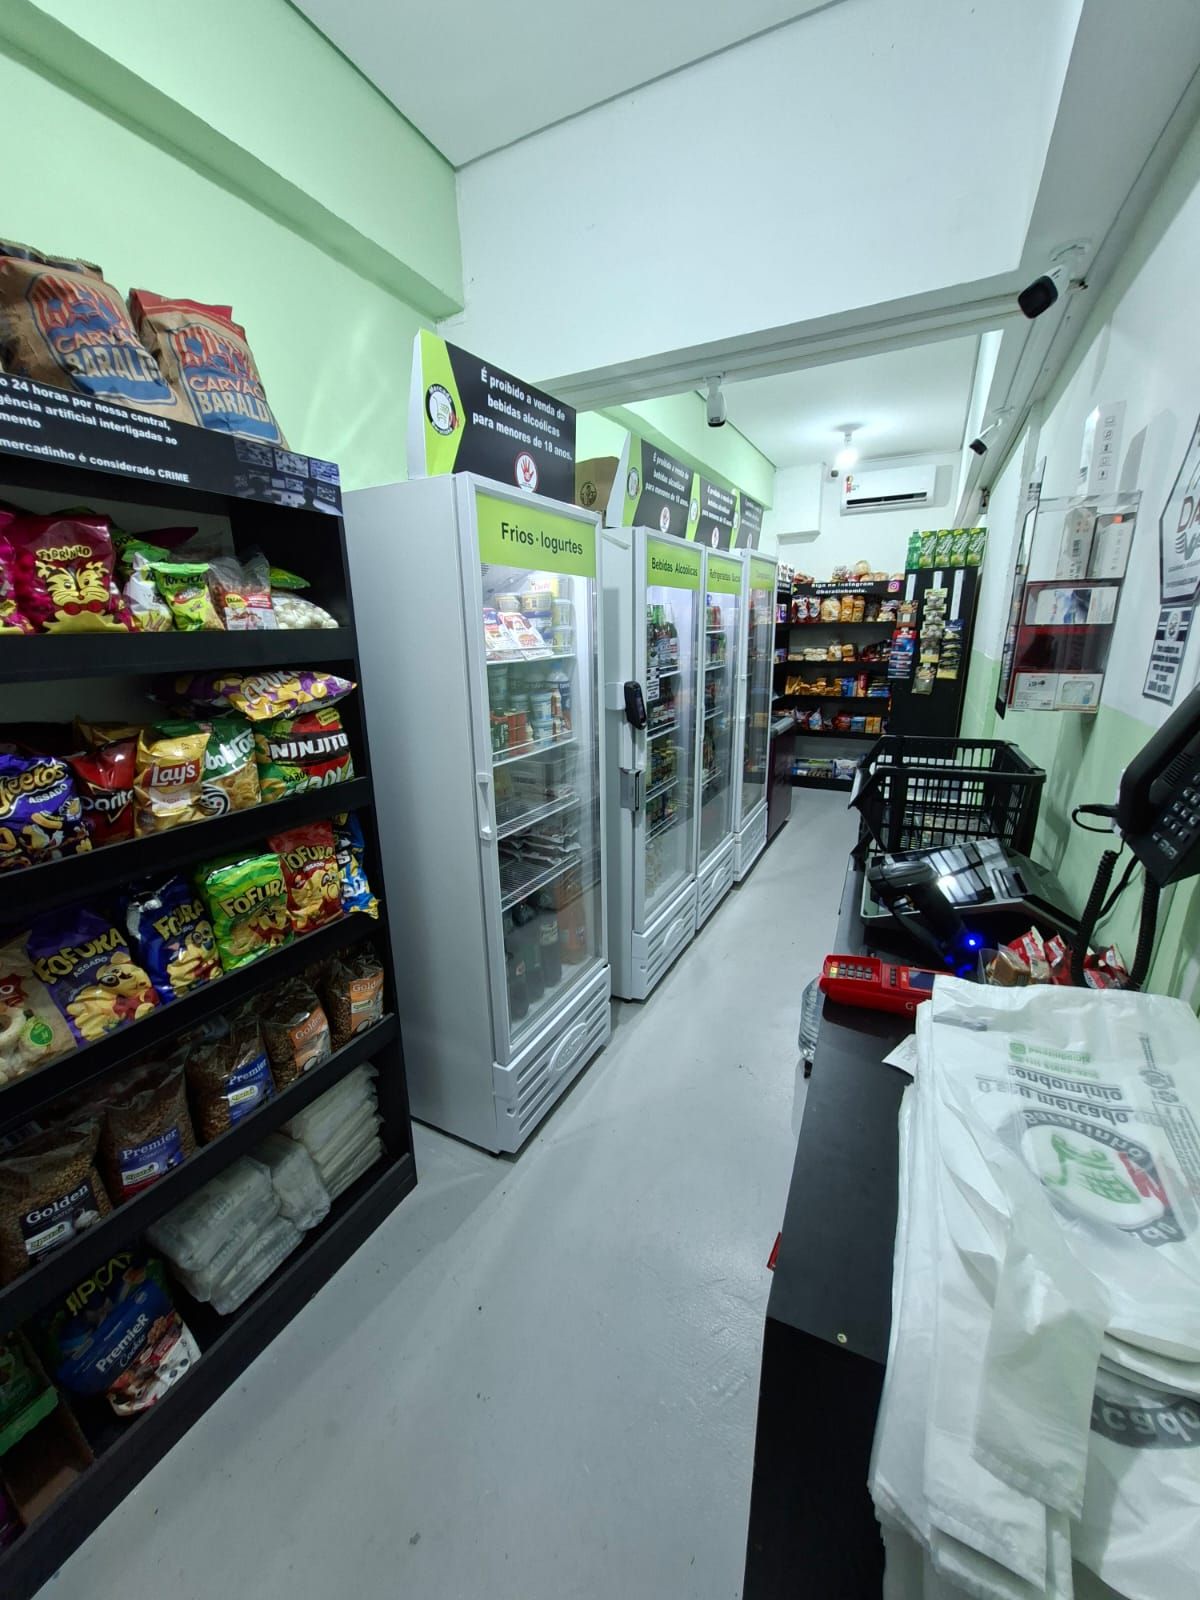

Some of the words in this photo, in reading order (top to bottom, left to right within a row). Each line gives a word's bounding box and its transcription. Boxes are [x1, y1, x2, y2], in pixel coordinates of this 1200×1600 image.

[12, 378, 30, 392] 24
[32, 384, 70, 403] horas
[72, 397, 92, 409] por
[95, 403, 129, 418] nossa
[131, 412, 171, 431] central,
[480, 366, 487, 383] É
[489, 375, 525, 401] proibido
[526, 393, 532, 403] a
[533, 396, 556, 417] venda
[556, 408, 566, 421] de
[0, 412, 42, 429] mento
[45, 406, 97, 426] artificial
[99, 418, 163, 444] interligadas
[165, 436, 178, 446] ao
[487, 394, 521, 421] bebidas
[523, 411, 560, 438] alcoólicas
[472, 411, 494, 430] para
[496, 420, 531, 444] menores
[532, 435, 543, 449] de
[544, 440, 553, 453] 18
[554, 445, 573, 461] anos.
[78, 452, 87, 463] é
[89, 455, 156, 477] considerado
[157, 468, 190, 483] CRIME
[501, 522, 534, 544] Frios
[540, 534, 583, 556] Iogurtes
[651, 557, 673, 572] Bebidas
[270, 733, 349, 760] NINJITO
[151, 762, 197, 786] Lay's
[29, 783, 68, 804] ASSADO
[73, 956, 108, 978] ASSADO
[229, 1058, 269, 1086] Premier
[122, 1128, 177, 1160] Premier
[26, 1185, 89, 1224] Golden
